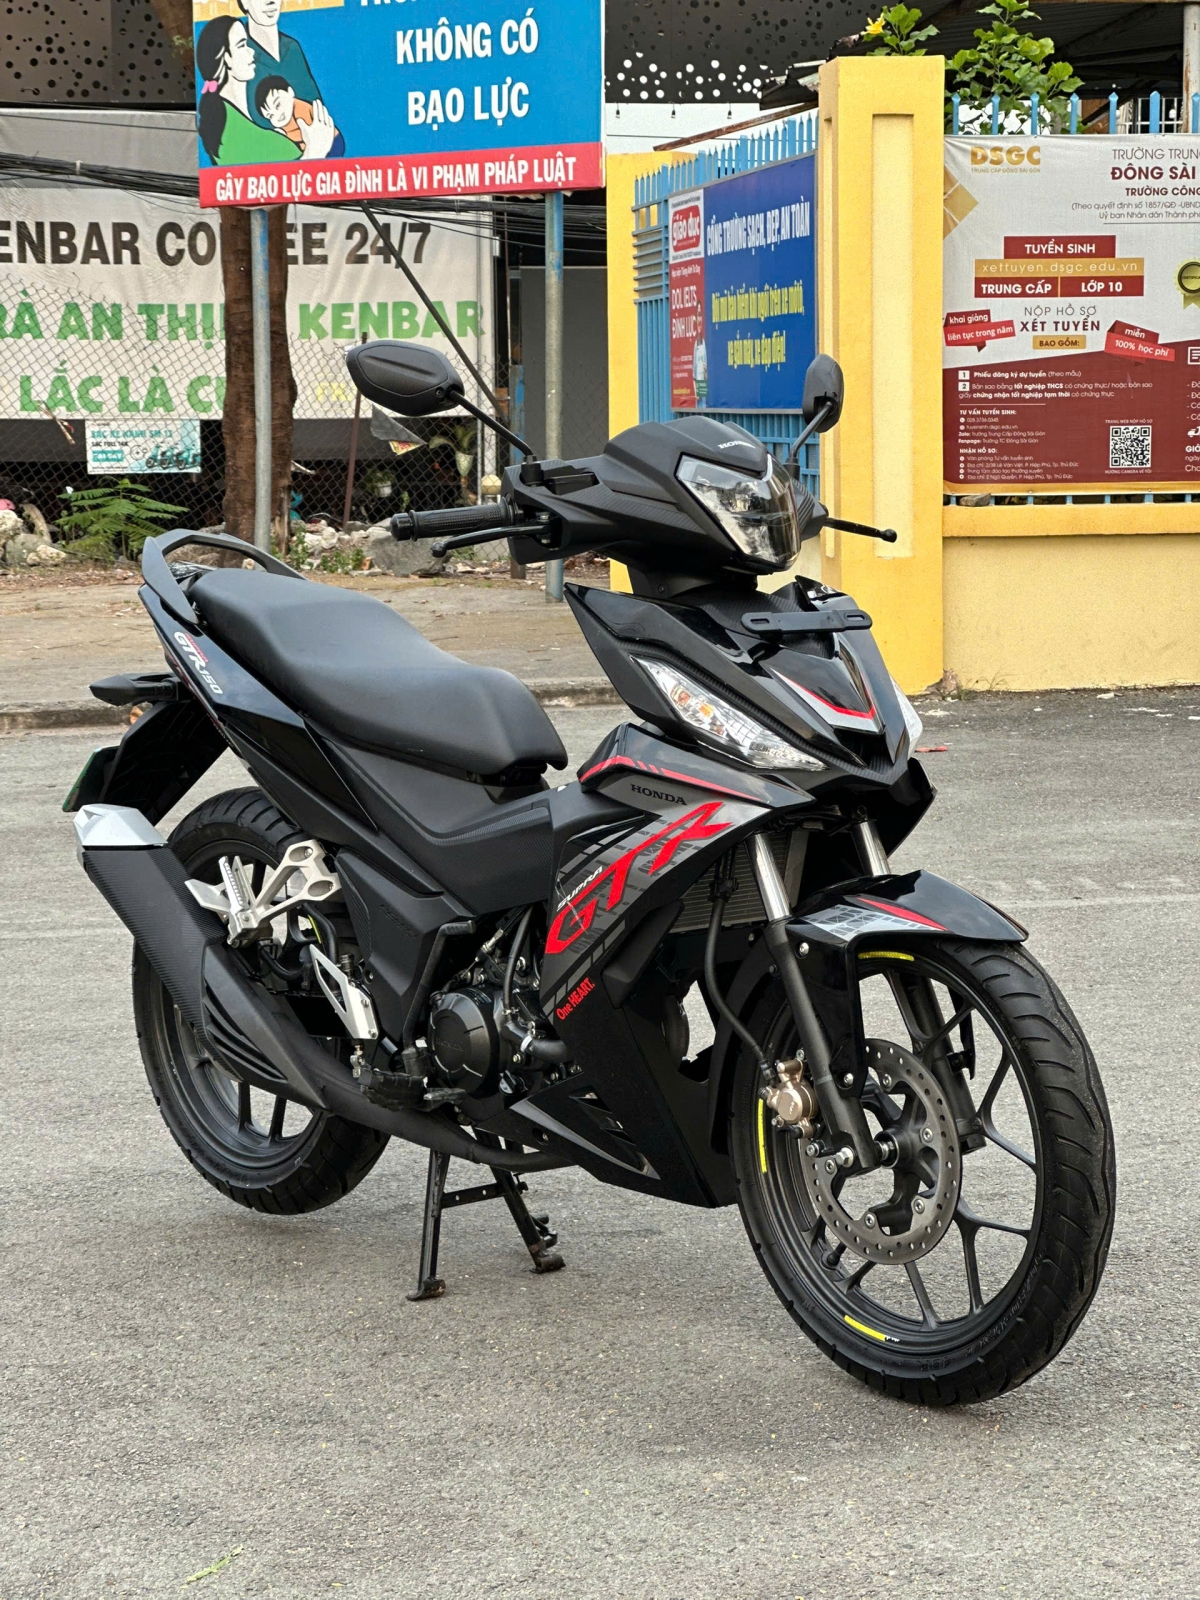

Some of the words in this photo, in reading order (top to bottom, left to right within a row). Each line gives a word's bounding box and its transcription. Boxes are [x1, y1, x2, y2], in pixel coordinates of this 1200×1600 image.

[396, 17, 491, 64] KHÔNG
[500, 8, 538, 55] CÓ
[408, 90, 464, 130] BẠO
[474, 77, 529, 126] LỰC
[970, 145, 1040, 166] DSGC
[1112, 147, 1165, 160] TRƯỜNG
[1168, 148, 1200, 160] TRUN
[216, 173, 243, 201] GÂY
[247, 174, 278, 202] BẠO
[283, 168, 312, 202] LỰC
[316, 170, 341, 195] GIA
[345, 164, 382, 194] ĐÌNH
[387, 160, 407, 192] LÀ
[411, 165, 427, 189] VI
[432, 162, 479, 191] PHẠM
[485, 154, 528, 186] PHÁP
[534, 151, 577, 183] LUẬT
[1110, 162, 1164, 180] ĐÔNG
[1169, 161, 1196, 180] SÀI
[1125, 185, 1168, 196] TRƯỜNG
[1071, 202, 1092, 210] (Theo
[1093, 201, 1115, 210] quyết
[1117, 201, 1133, 210] định
[1135, 201, 1143, 209] số
[1145, 201, 1177, 209] 1857/QĐ
[1110, 211, 1125, 219] ban
[1126, 211, 1146, 219] Nhân
[1148, 211, 1163, 219] dân
[1165, 211, 1187, 219] Thành
[707, 214, 722, 256] CỔNG
[723, 211, 747, 253] TRƯỜNG
[747, 212, 765, 255] SẠCH,
[780, 205, 790, 241] AN
[791, 195, 810, 239] TOÀN
[156, 220, 328, 266] COEE
[345, 221, 431, 269] 24/7
[1024, 238, 1063, 254] TUYỂN
[1067, 243, 1096, 254] SINH
[982, 262, 1138, 274] xettuyen.dsgc.edu.vn
[981, 283, 1022, 295] TRUNG
[1025, 279, 1052, 294] CẤP
[1081, 279, 1105, 293] LỚP
[1108, 281, 1123, 293] 10
[949, 314, 966, 324] khai
[967, 313, 988, 324] giảng
[1024, 304, 1051, 317] NỘP
[1056, 302, 1075, 316] HỒ
[1079, 304, 1097, 316] SƠ
[57, 302, 122, 340] AN
[138, 303, 225, 351] THỊ
[299, 300, 486, 340] KENBAR
[1020, 318, 1047, 332] XÉT
[1053, 314, 1100, 332] TUYỂN
[947, 333, 961, 341] liên
[962, 332, 974, 340] tục
[975, 329, 996, 337] trong
[996, 326, 1013, 334] năm
[1039, 339, 1056, 347] BAO
[1058, 337, 1080, 347] GỒM:
[1124, 328, 1146, 339] miễn
[1115, 339, 1136, 350] 100%
[1138, 343, 1153, 354] học
[1154, 348, 1169, 357] phí
[992, 371, 1009, 379] đăng
[19, 358, 103, 413] LẮC
[118, 363, 175, 413] LÀ
[1021, 391, 1043, 399] nghiệp
[174, 631, 206, 668] GTR
[200, 669, 223, 695] 150
[630, 783, 688, 806] HONDA
[545, 801, 735, 954] GTR
[556, 865, 603, 912] SUPRA
[556, 1002, 573, 1020] One
[567, 977, 596, 1008] HEART.
